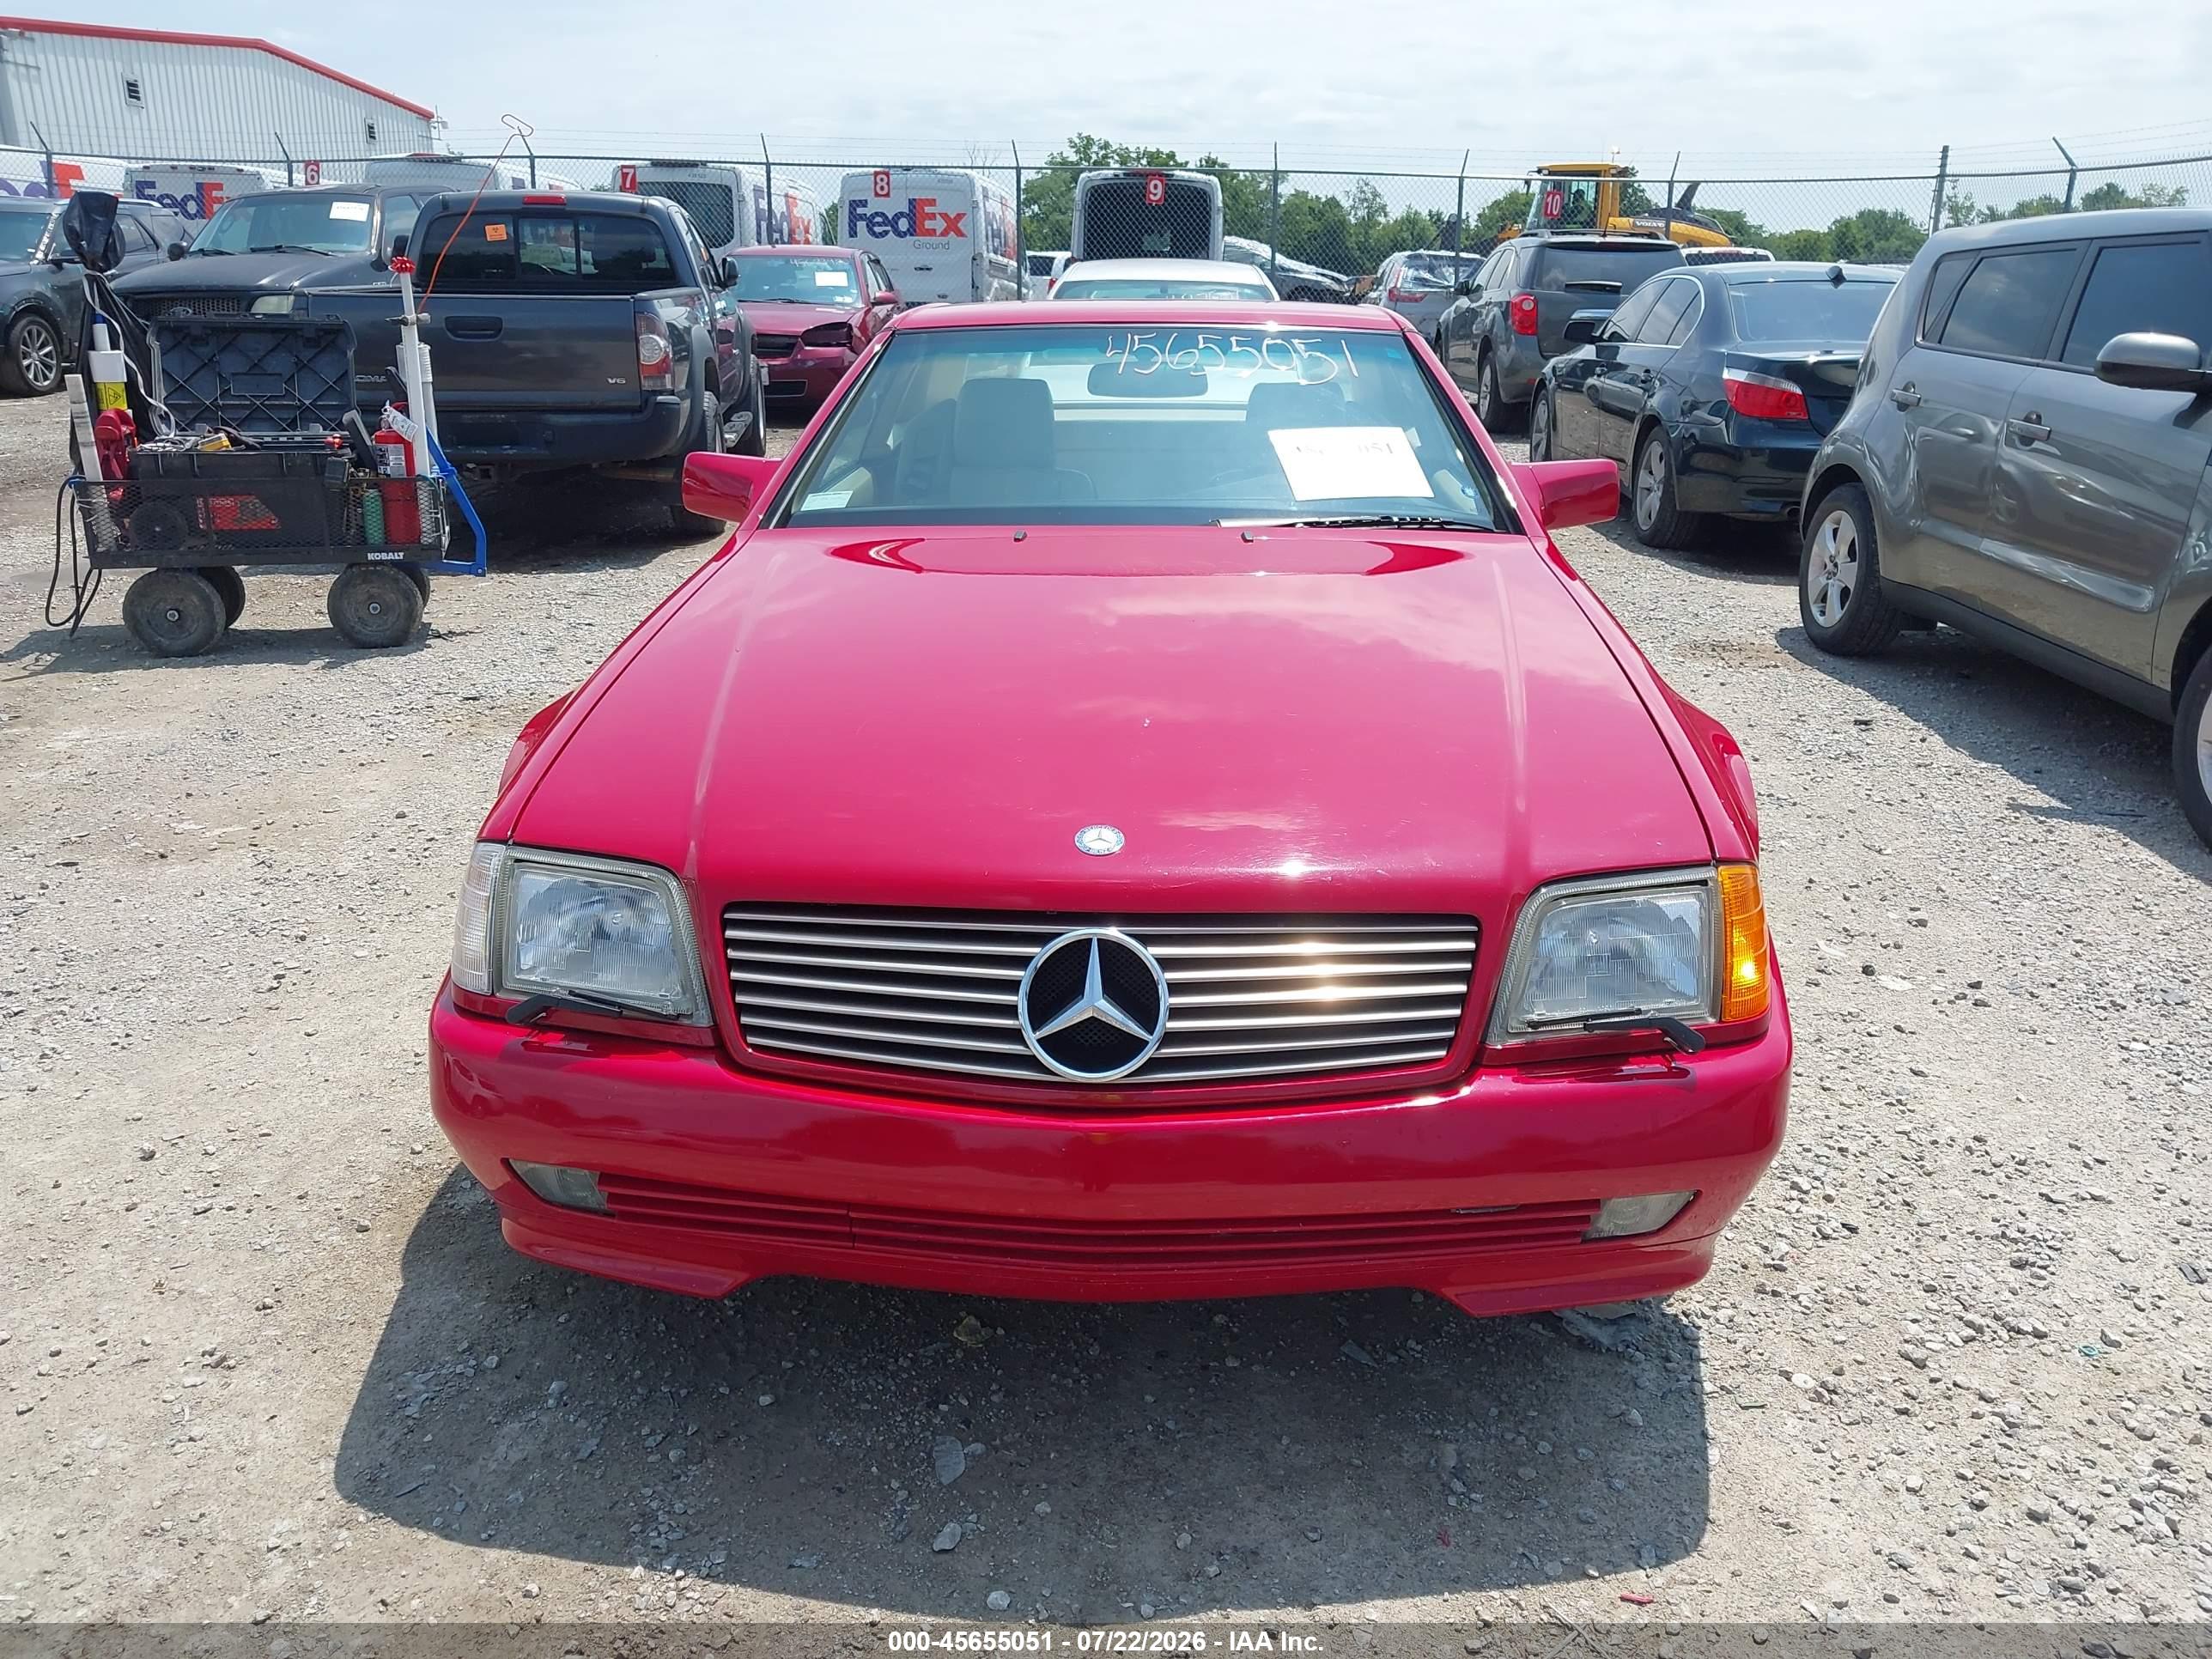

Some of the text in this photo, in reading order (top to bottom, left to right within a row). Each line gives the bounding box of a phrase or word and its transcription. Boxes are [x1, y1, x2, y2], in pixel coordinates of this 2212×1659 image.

[307, 164, 319, 185] 6
[623, 167, 634, 188] 7
[876, 173, 889, 196] 8
[136, 180, 230, 220] FedE
[1149, 179, 1163, 201] 9
[1547, 194, 1561, 216] 10
[848, 198, 968, 239] FedEx
[913, 240, 950, 250] Ground
[1106, 332, 1359, 386] 45655051
[367, 552, 404, 561] KOBALT
